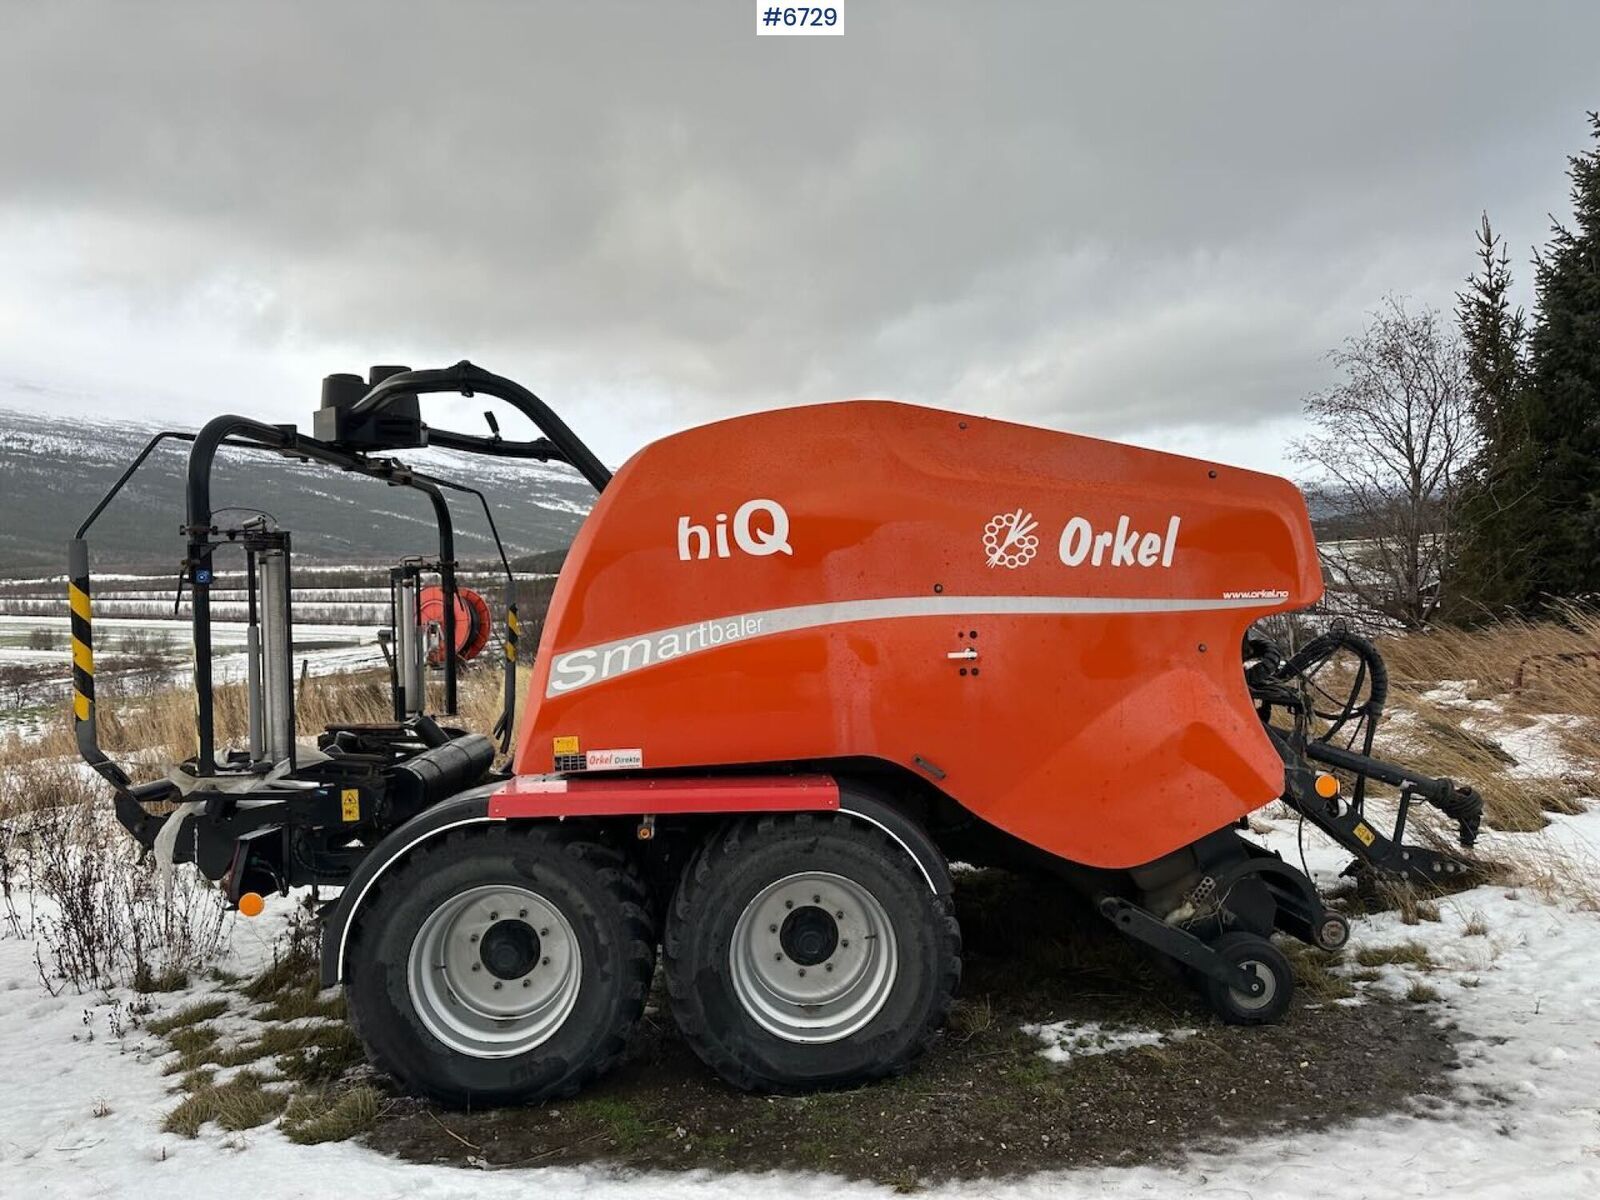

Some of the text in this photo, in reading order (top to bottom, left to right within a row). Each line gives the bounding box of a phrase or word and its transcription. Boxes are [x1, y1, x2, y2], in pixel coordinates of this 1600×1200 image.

[677, 499, 793, 561] hiQ
[1059, 515, 1181, 568] Orkel
[1223, 589, 1289, 599] www.orkel.no
[551, 616, 764, 691] Smartbaler
[589, 753, 641, 765] Orkel Direkte
